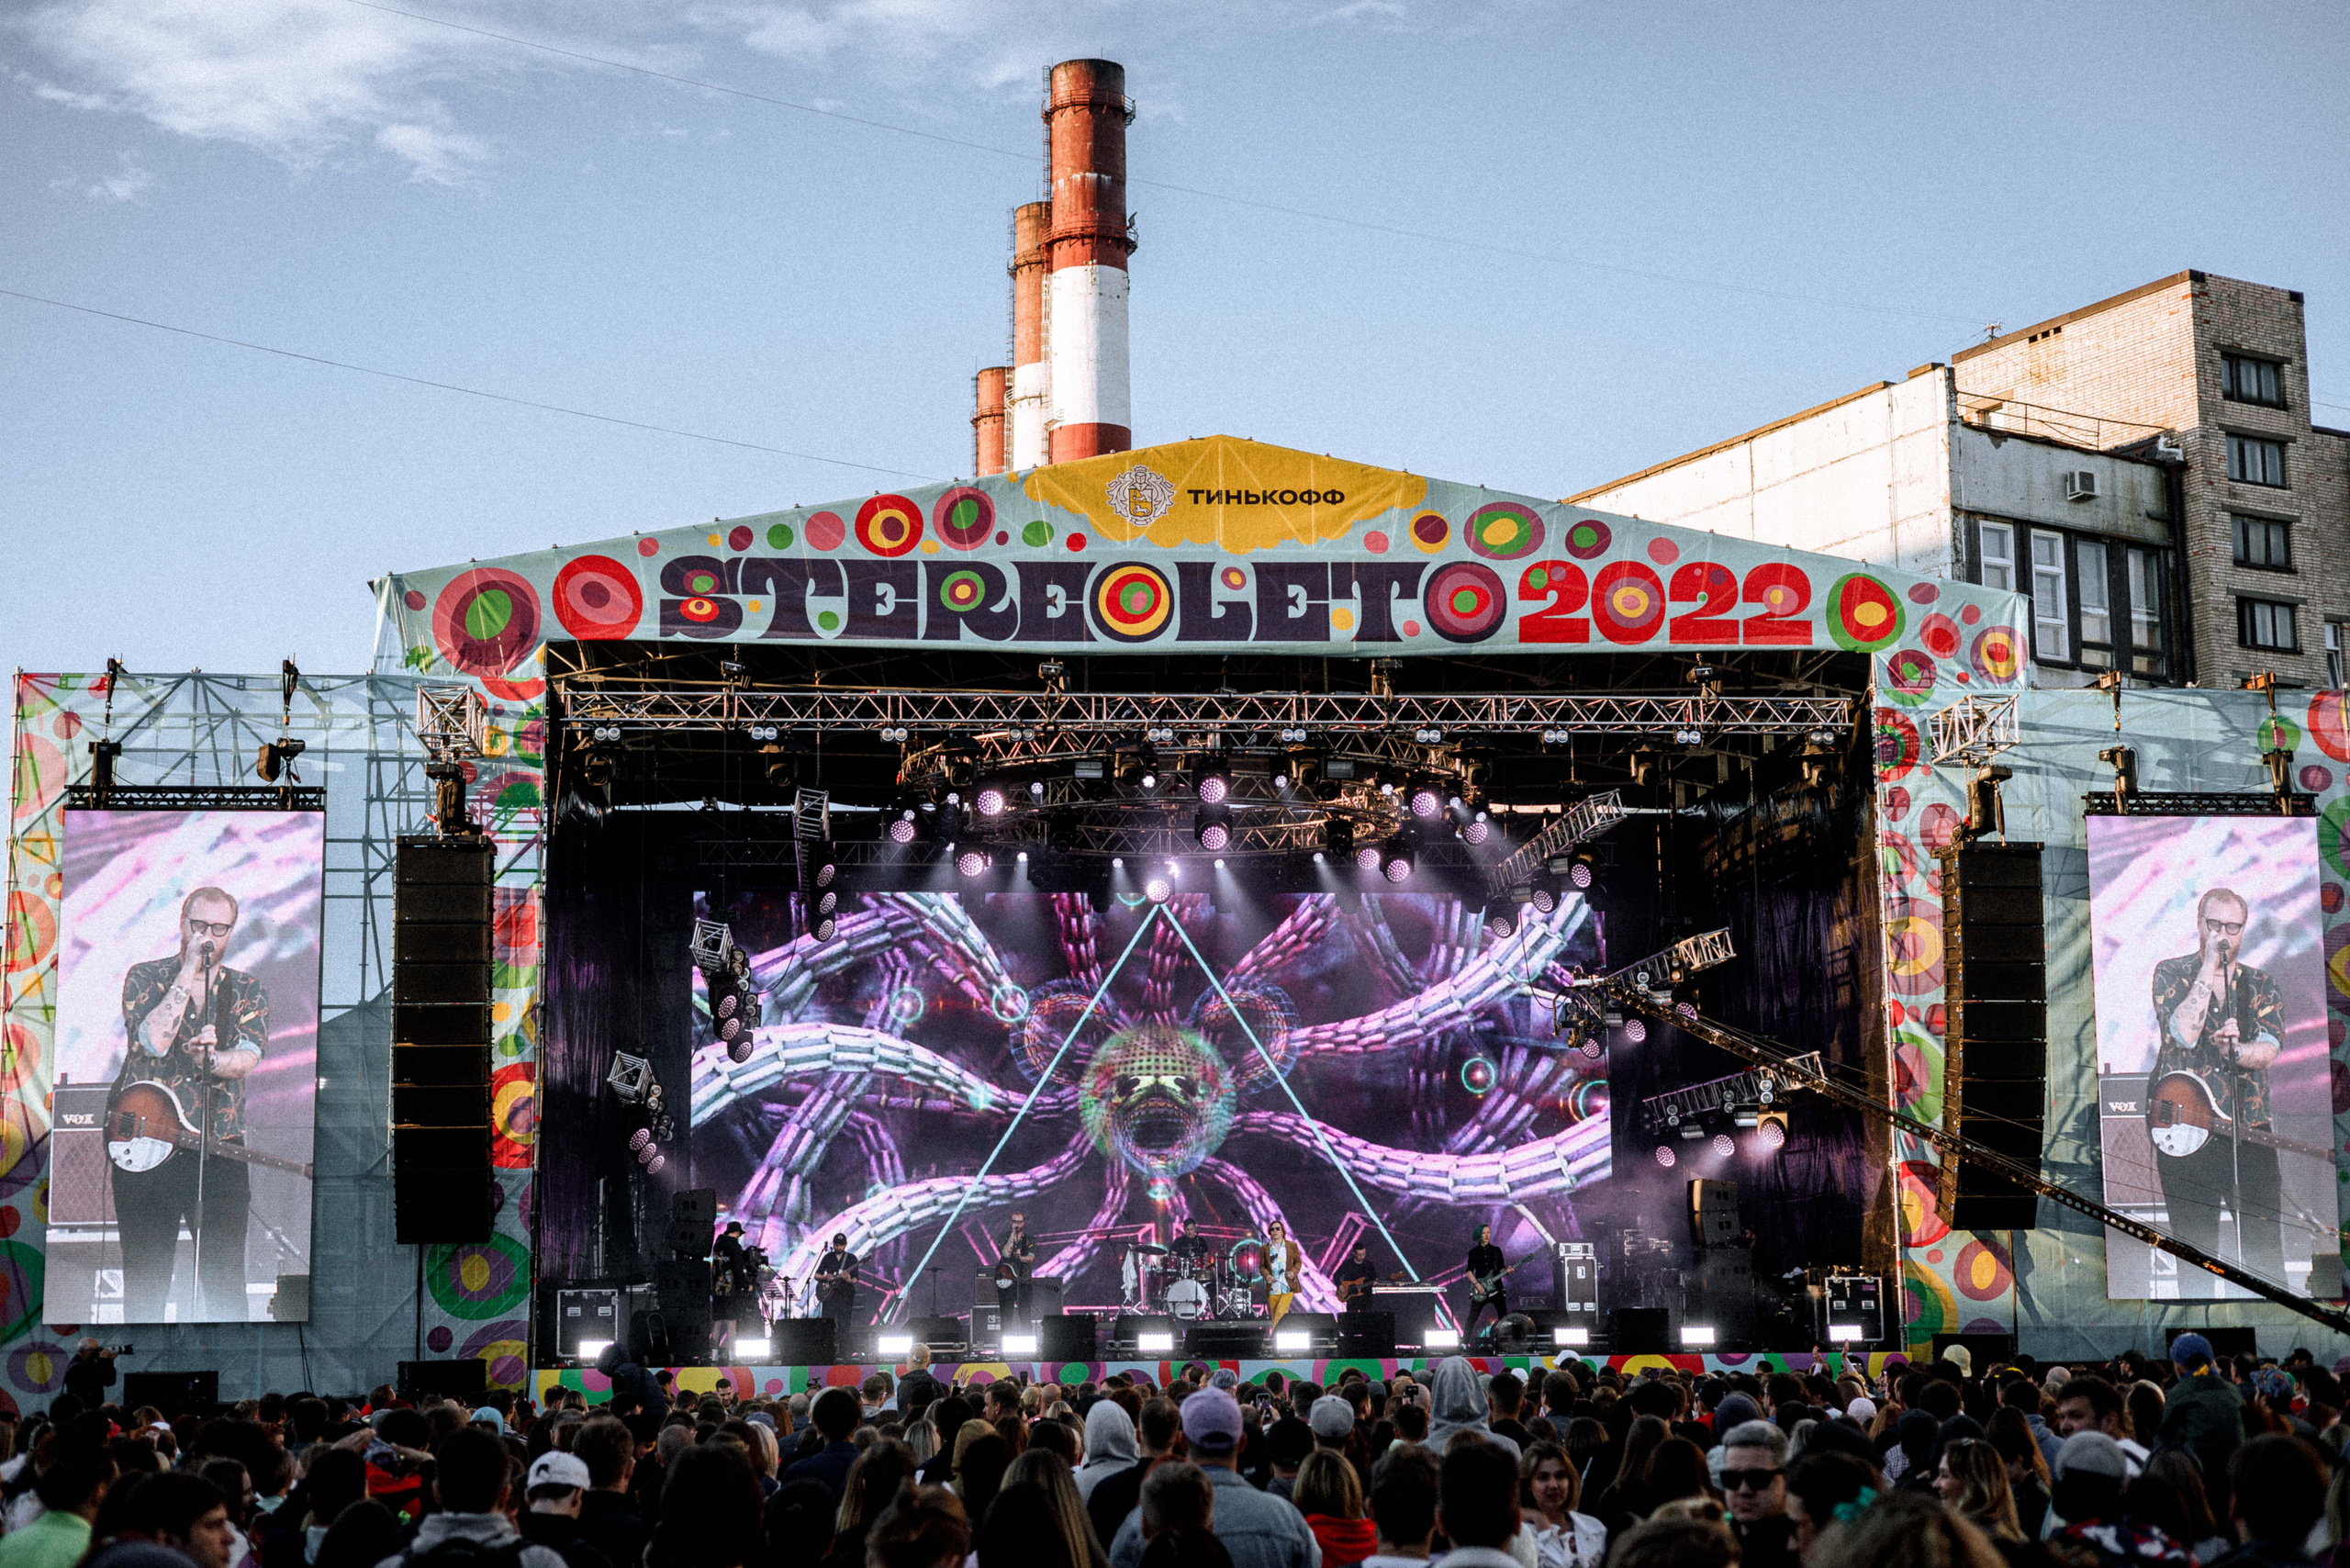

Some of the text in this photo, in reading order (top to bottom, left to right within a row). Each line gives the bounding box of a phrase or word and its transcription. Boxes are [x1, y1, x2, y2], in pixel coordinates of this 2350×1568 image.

[1187, 489, 1346, 506] ТИНЬКОФФ
[659, 554, 1814, 646] STEREOLETO 2022
[2108, 1102, 2138, 1113] VOX
[62, 1114, 95, 1125] VOX
